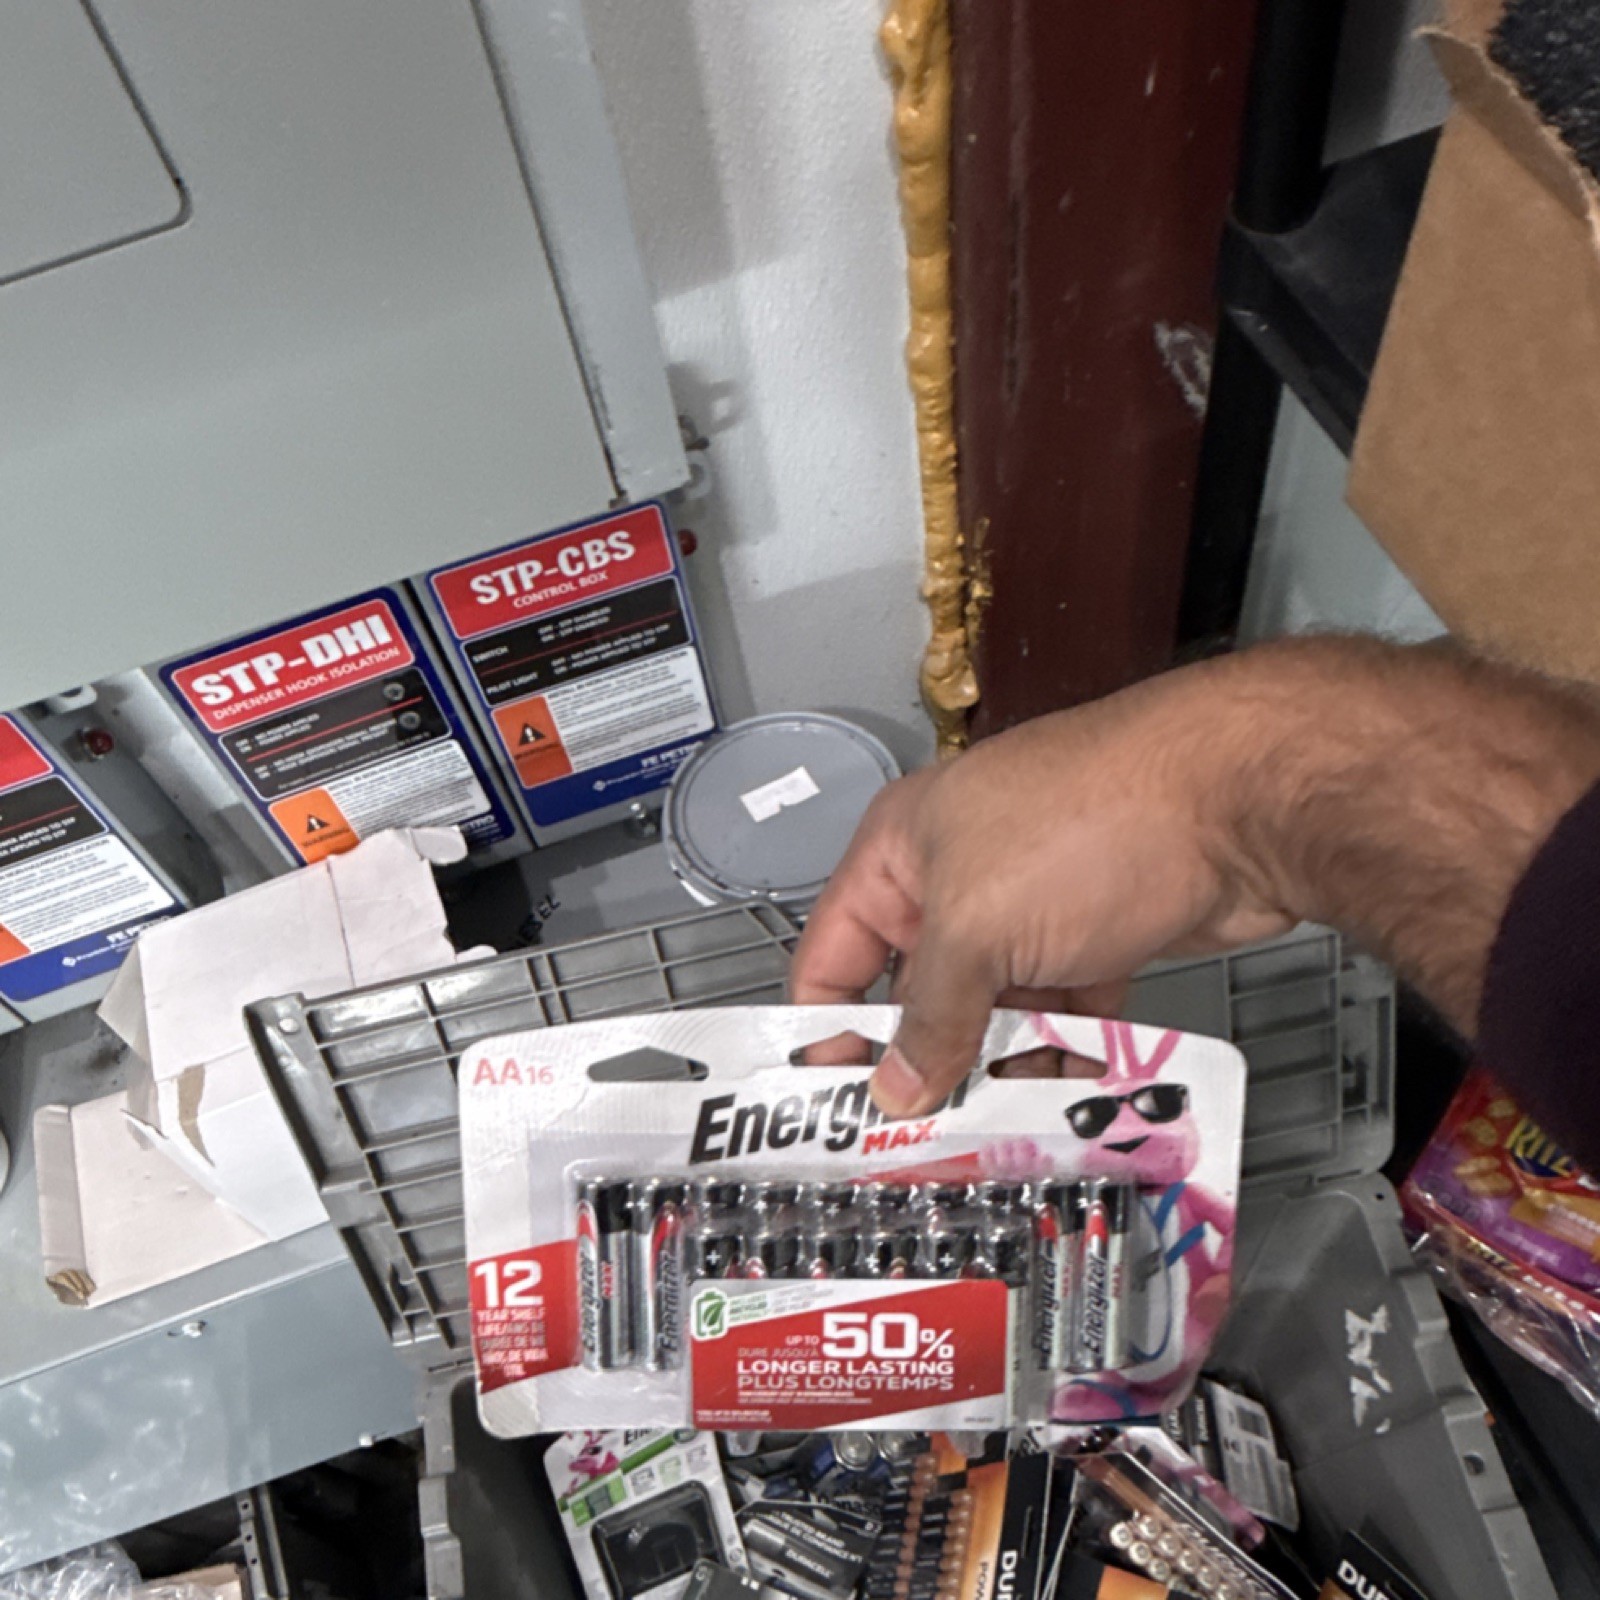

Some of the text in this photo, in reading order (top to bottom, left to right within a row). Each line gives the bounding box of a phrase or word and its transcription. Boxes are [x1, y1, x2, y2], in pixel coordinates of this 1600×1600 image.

[470, 530, 635, 604] STP-CBS
[512, 571, 608, 608] CONTROL BOX
[190, 614, 393, 706] STP-DHI
[472, 646, 508, 663] SWITCH
[211, 646, 401, 722] DISPENSER HOOK ISOLATION
[486, 671, 538, 694] PILOT LIGHT
[472, 1057, 554, 1086] AA 16
[861, 1119, 937, 1156] MAX
[1503, 1116, 1572, 1178] RITZ
[474, 1260, 544, 1308] 12
[476, 1306, 547, 1322] YEAR SHELF
[785, 1311, 954, 1359] UP TO 50%
[737, 1360, 954, 1375] LONGER LASTING
[737, 1375, 955, 1391] PLUS LONGTEMPS
